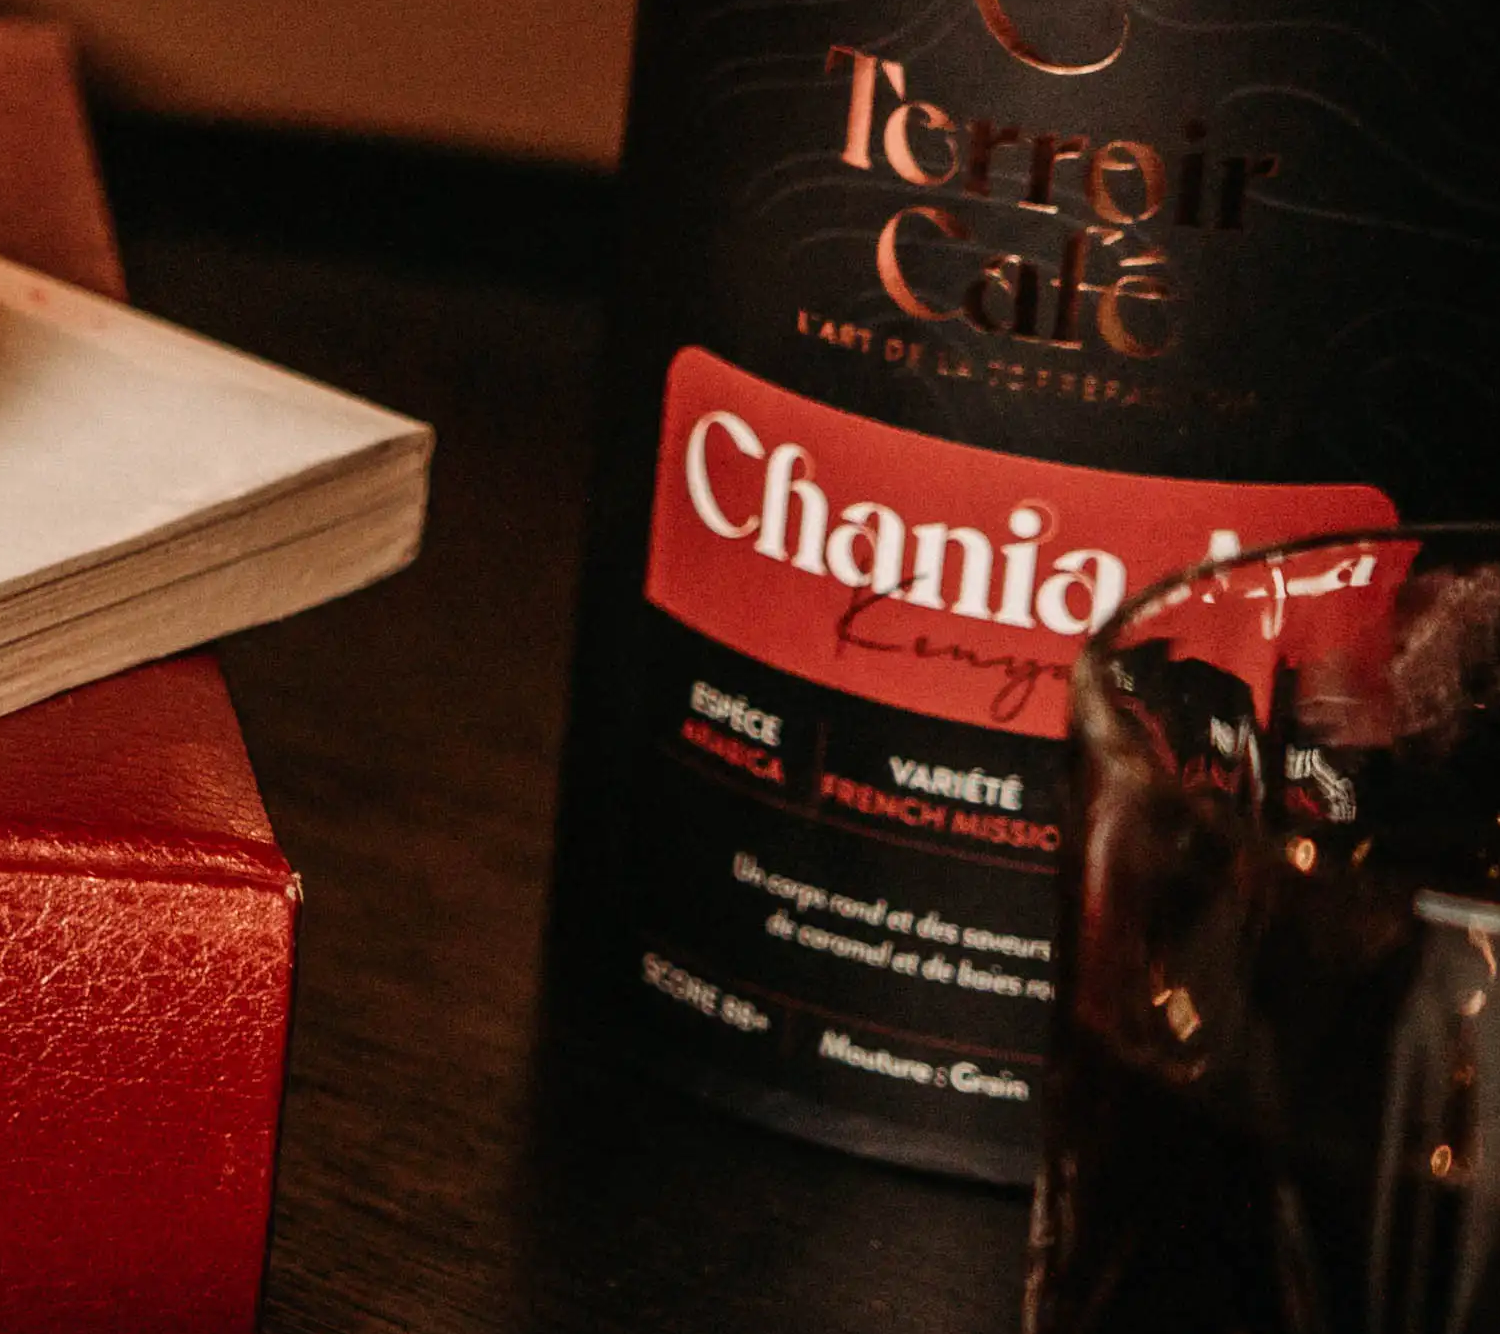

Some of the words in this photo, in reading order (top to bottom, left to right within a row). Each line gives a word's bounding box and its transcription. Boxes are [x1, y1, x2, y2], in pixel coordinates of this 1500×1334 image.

[825, 44, 1282, 233] Terroir
[875, 206, 1182, 359] Café
[685, 408, 1128, 636] Chania
[819, 772, 945, 829] FRENCH
[951, 808, 1063, 854] MISSIO
[888, 753, 1025, 811] VARIÉTÉ
[915, 910, 960, 946] des
[818, 1028, 934, 1086] Mouture
[949, 1061, 1031, 1102] Grain
